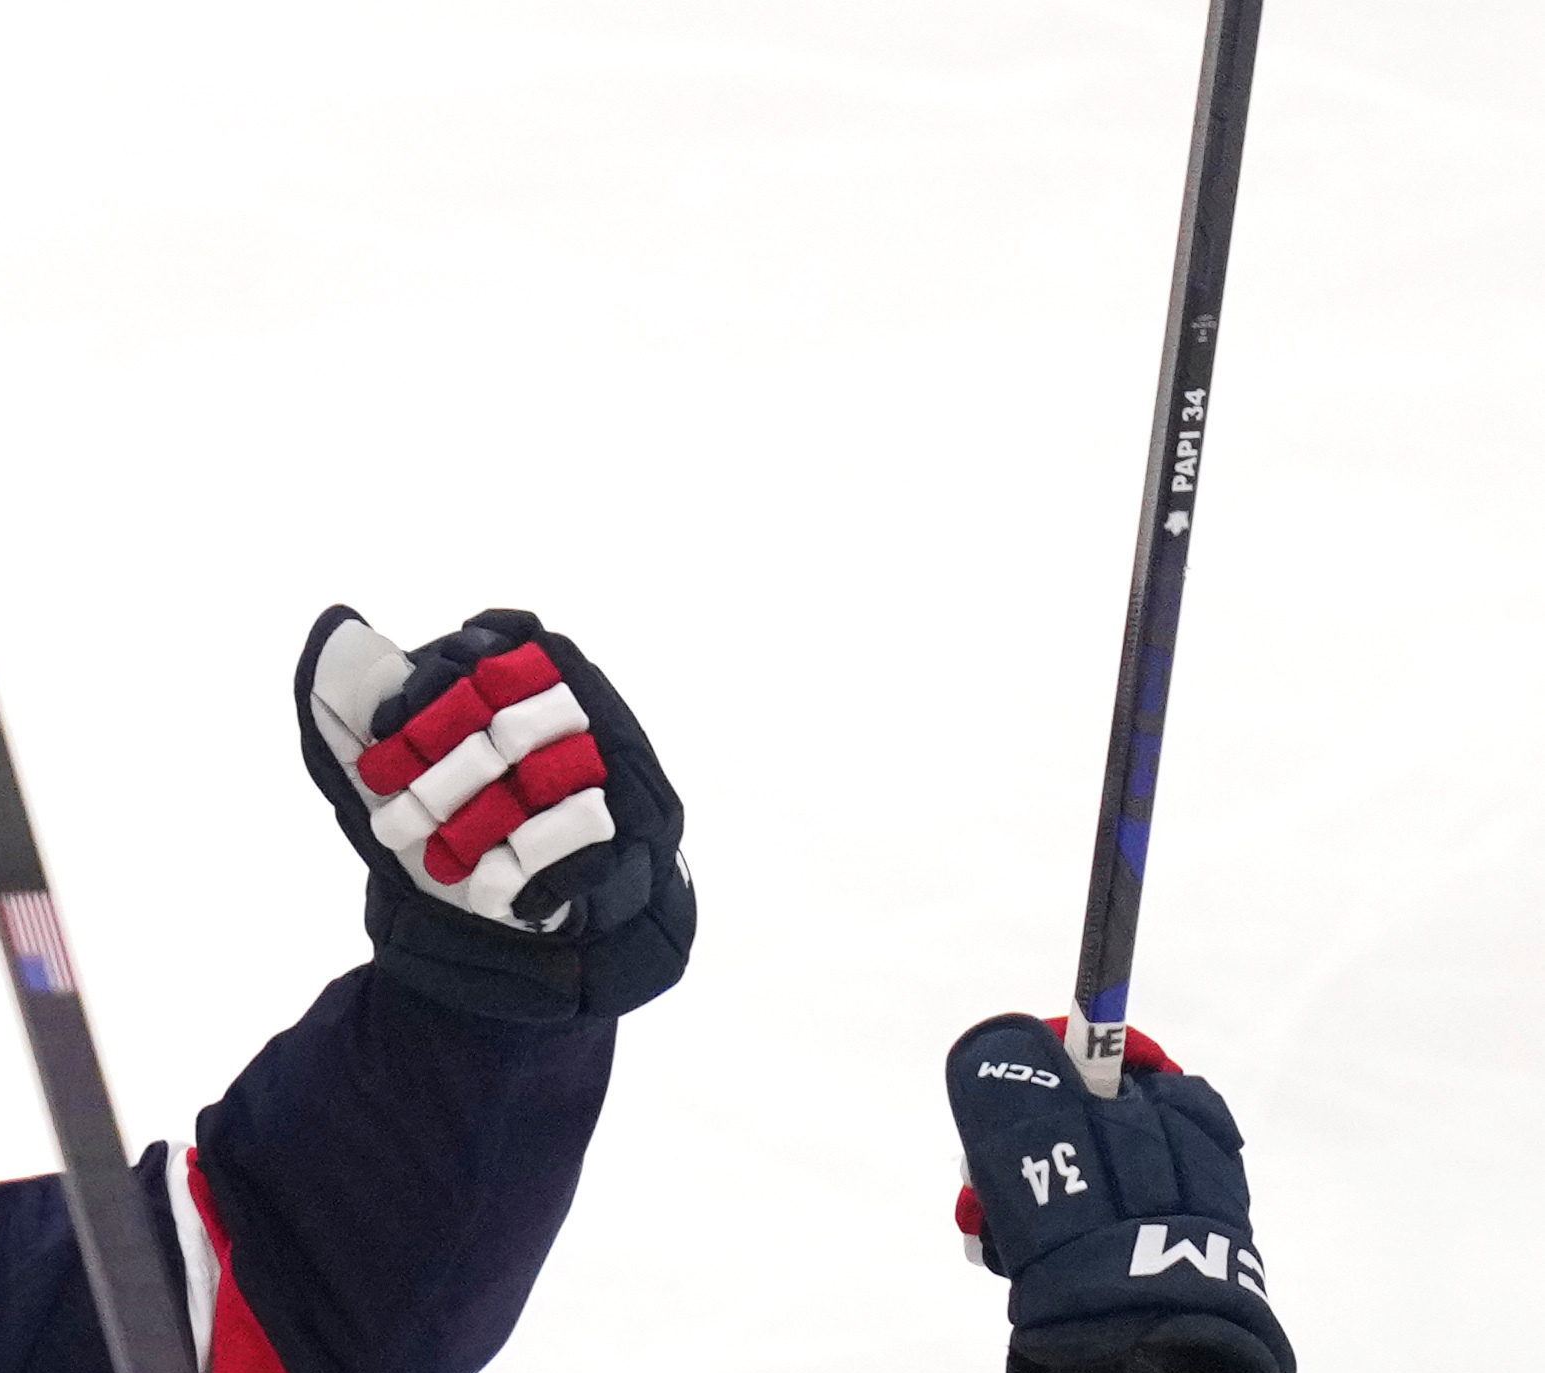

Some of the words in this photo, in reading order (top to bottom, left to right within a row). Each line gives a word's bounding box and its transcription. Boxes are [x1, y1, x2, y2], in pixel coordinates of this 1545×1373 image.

[1180, 388, 1207, 421] 34
[1172, 426, 1203, 494] PAPI
[977, 1059, 1062, 1090] CCM
[1020, 1142, 1088, 1207] 34
